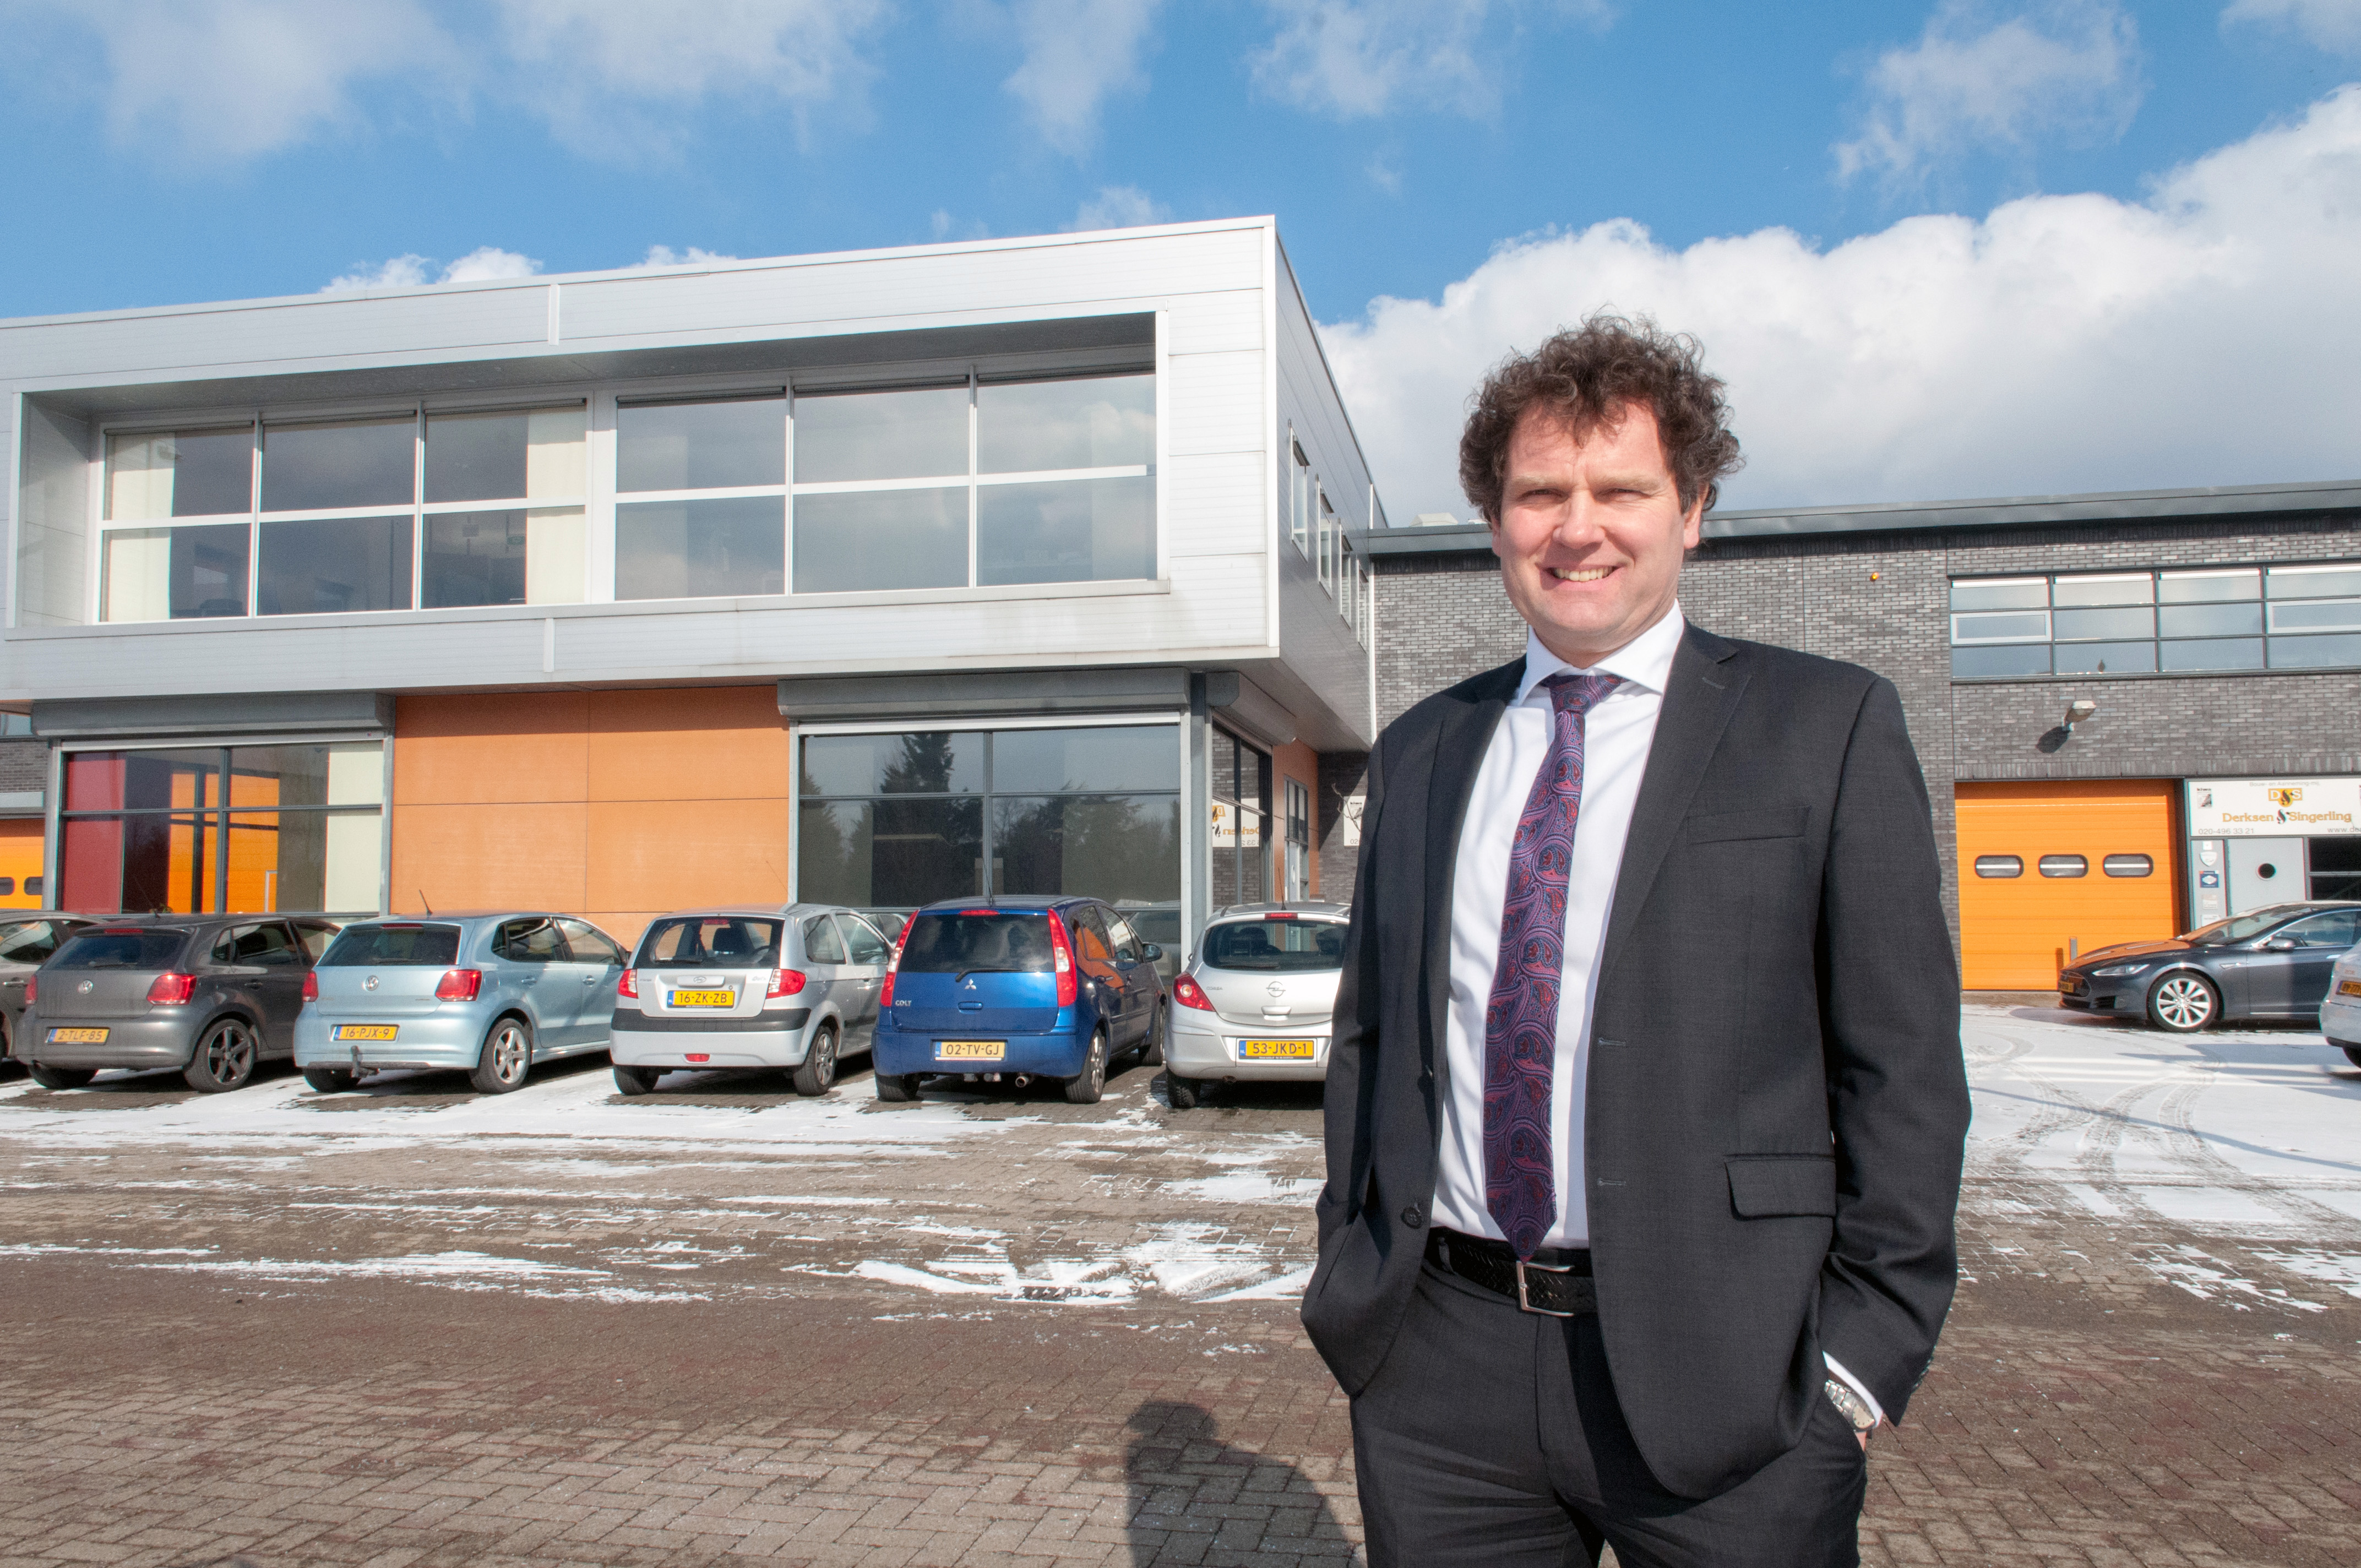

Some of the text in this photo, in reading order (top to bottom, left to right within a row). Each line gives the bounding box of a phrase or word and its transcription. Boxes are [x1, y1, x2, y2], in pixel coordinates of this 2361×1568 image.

[2222, 812, 2274, 823] Derksen
[2288, 811, 2352, 823] Singerling
[680, 993, 727, 1003] 16-ZK-ZB
[58, 1030, 102, 1041] 2-TLF-85
[345, 1028, 390, 1038] 16-PJX-9
[946, 1044, 999, 1055] 02-TV-GJ
[1253, 1043, 1307, 1054] 53-JKD-1
